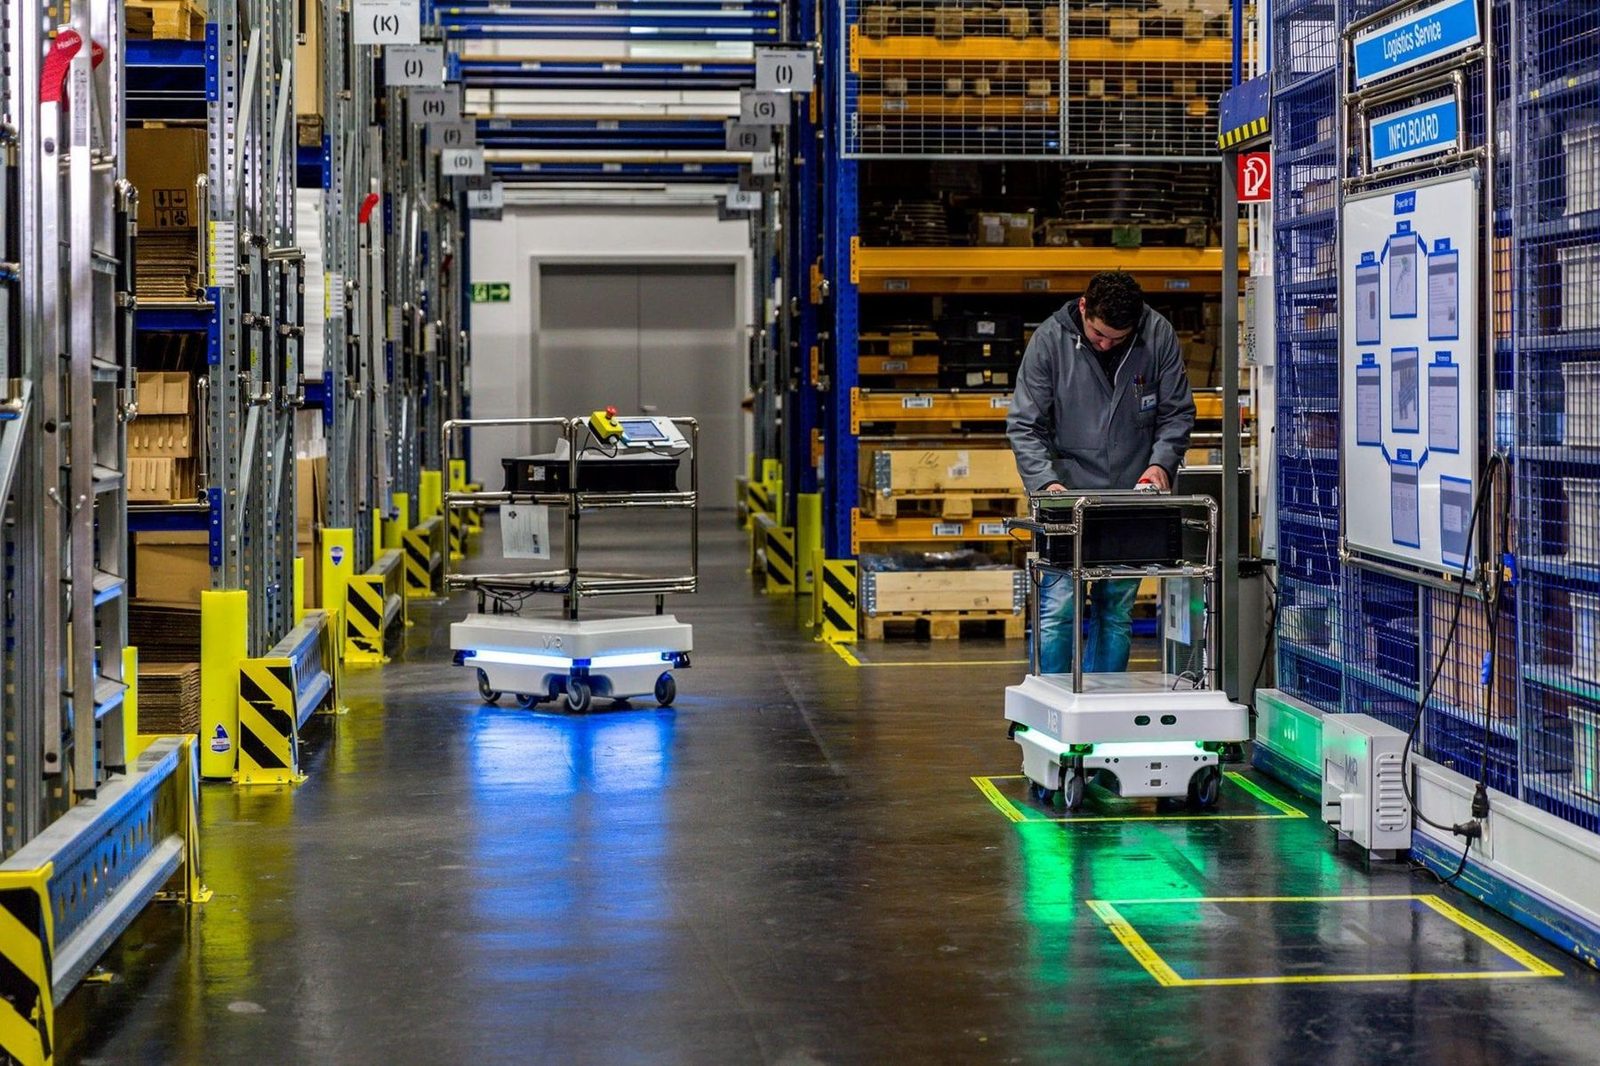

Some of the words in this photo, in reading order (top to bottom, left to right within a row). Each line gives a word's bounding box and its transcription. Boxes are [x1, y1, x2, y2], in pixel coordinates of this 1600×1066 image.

[373, 14, 399, 36] (K)
[1382, 29, 1414, 63] Logistics
[1414, 18, 1442, 48] Service
[404, 59, 423, 78] (J)
[775, 64, 793, 84] (I)
[423, 100, 445, 116] (H)
[753, 102, 776, 118] (G)
[444, 129, 461, 144] (F)
[739, 132, 757, 147] (E)
[1388, 121, 1408, 151] INFO
[1408, 113, 1439, 146] BOARD
[454, 156, 473, 169] (D)
